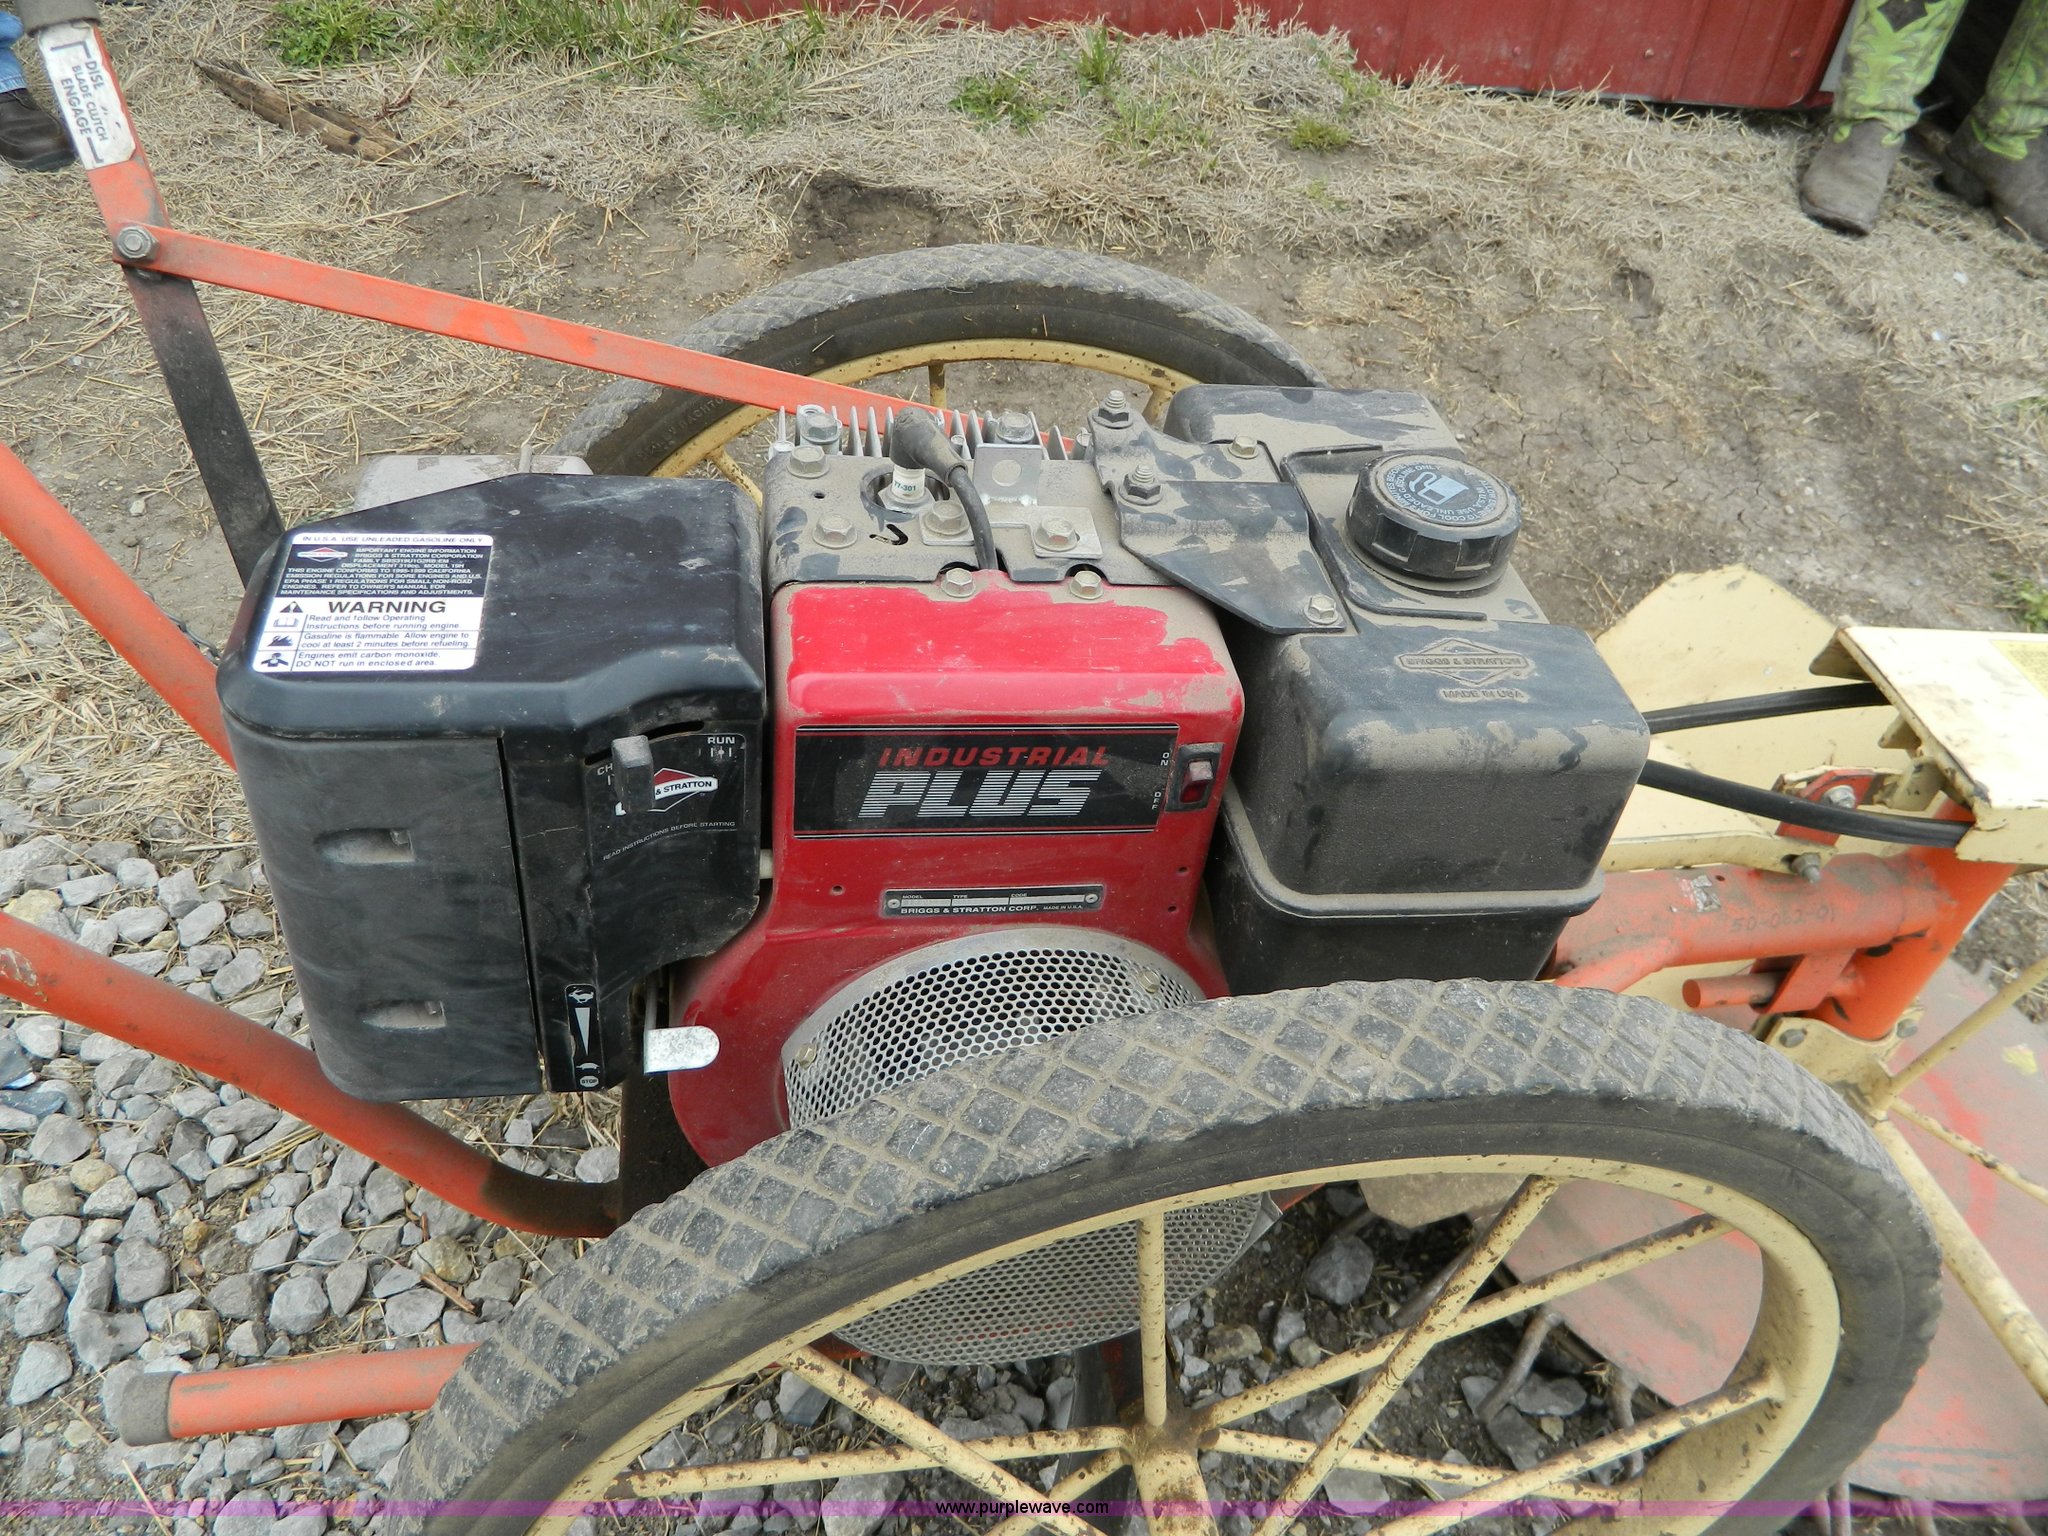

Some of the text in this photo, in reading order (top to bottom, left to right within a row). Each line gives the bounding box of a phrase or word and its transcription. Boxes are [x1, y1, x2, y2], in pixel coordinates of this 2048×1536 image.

[61, 78, 92, 135] ENGAGE
[72, 65, 108, 141] BLADE CLUTCH
[1404, 493, 1455, 515] UNLEADED
[1456, 505, 1476, 514] USE
[328, 601, 446, 613] WARNING
[298, 652, 335, 660] Engines
[1406, 657, 1450, 665] BRIGGS
[1463, 657, 1521, 665] STRATTON
[1442, 690, 1479, 698] MADE
[707, 736, 736, 745] RUN
[878, 746, 1110, 767] INDUSTRIAL
[1161, 752, 1170, 766] ON
[655, 780, 713, 796] & STRATTON
[857, 769, 1103, 818] PLUS
[1151, 791, 1162, 810] OFF
[603, 849, 621, 861] READ
[622, 828, 669, 851] INSTRUCTIONS
[670, 822, 698, 831] BEFORE
